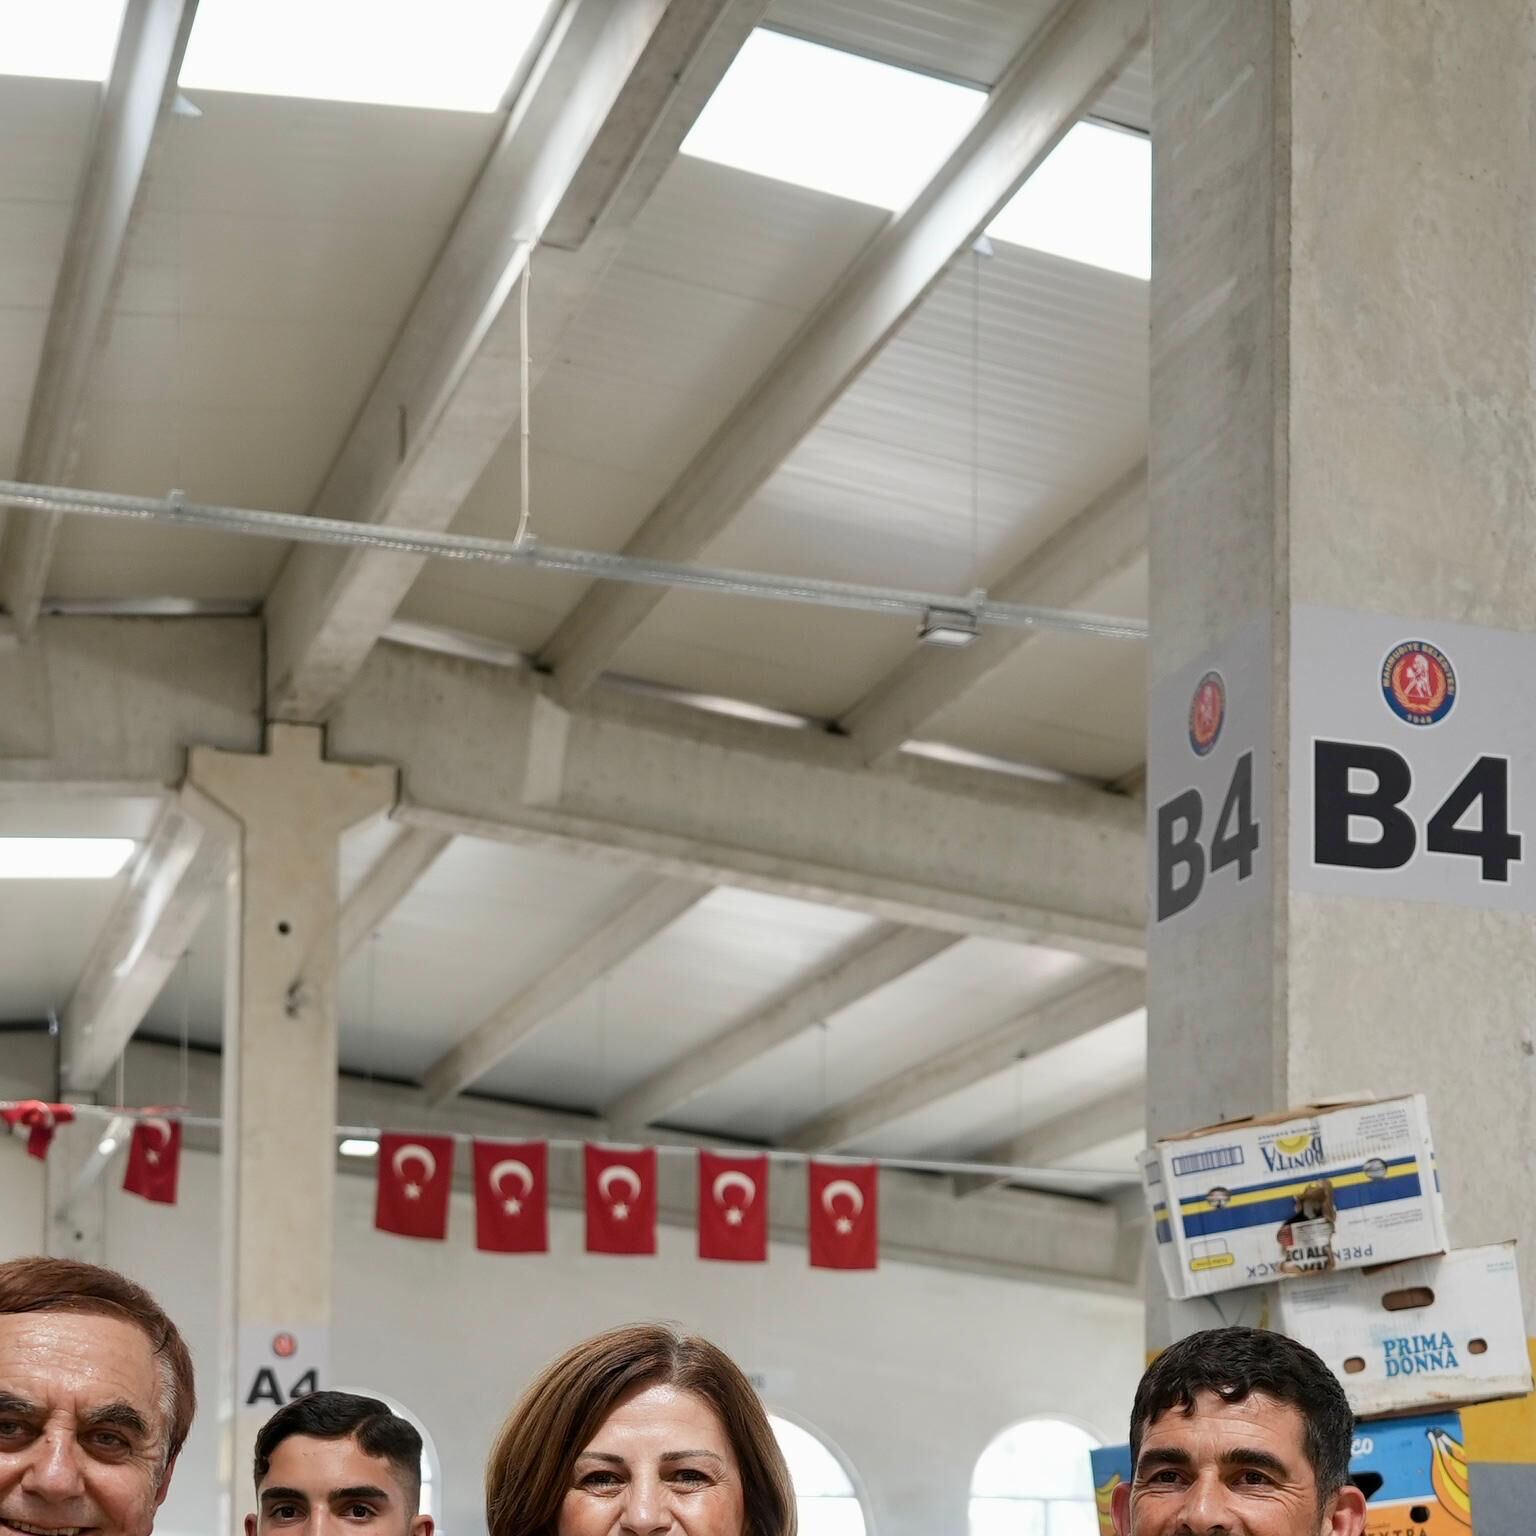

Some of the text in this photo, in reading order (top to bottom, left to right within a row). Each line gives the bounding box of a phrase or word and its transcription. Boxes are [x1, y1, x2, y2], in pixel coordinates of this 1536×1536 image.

[1314, 739, 1522, 883] B4
[1158, 751, 1260, 922] B4
[1260, 1136, 1324, 1173] BONITA
[1382, 1330, 1454, 1358] PRIMA
[1385, 1350, 1459, 1377] DONNA
[246, 1366, 319, 1405] A4
